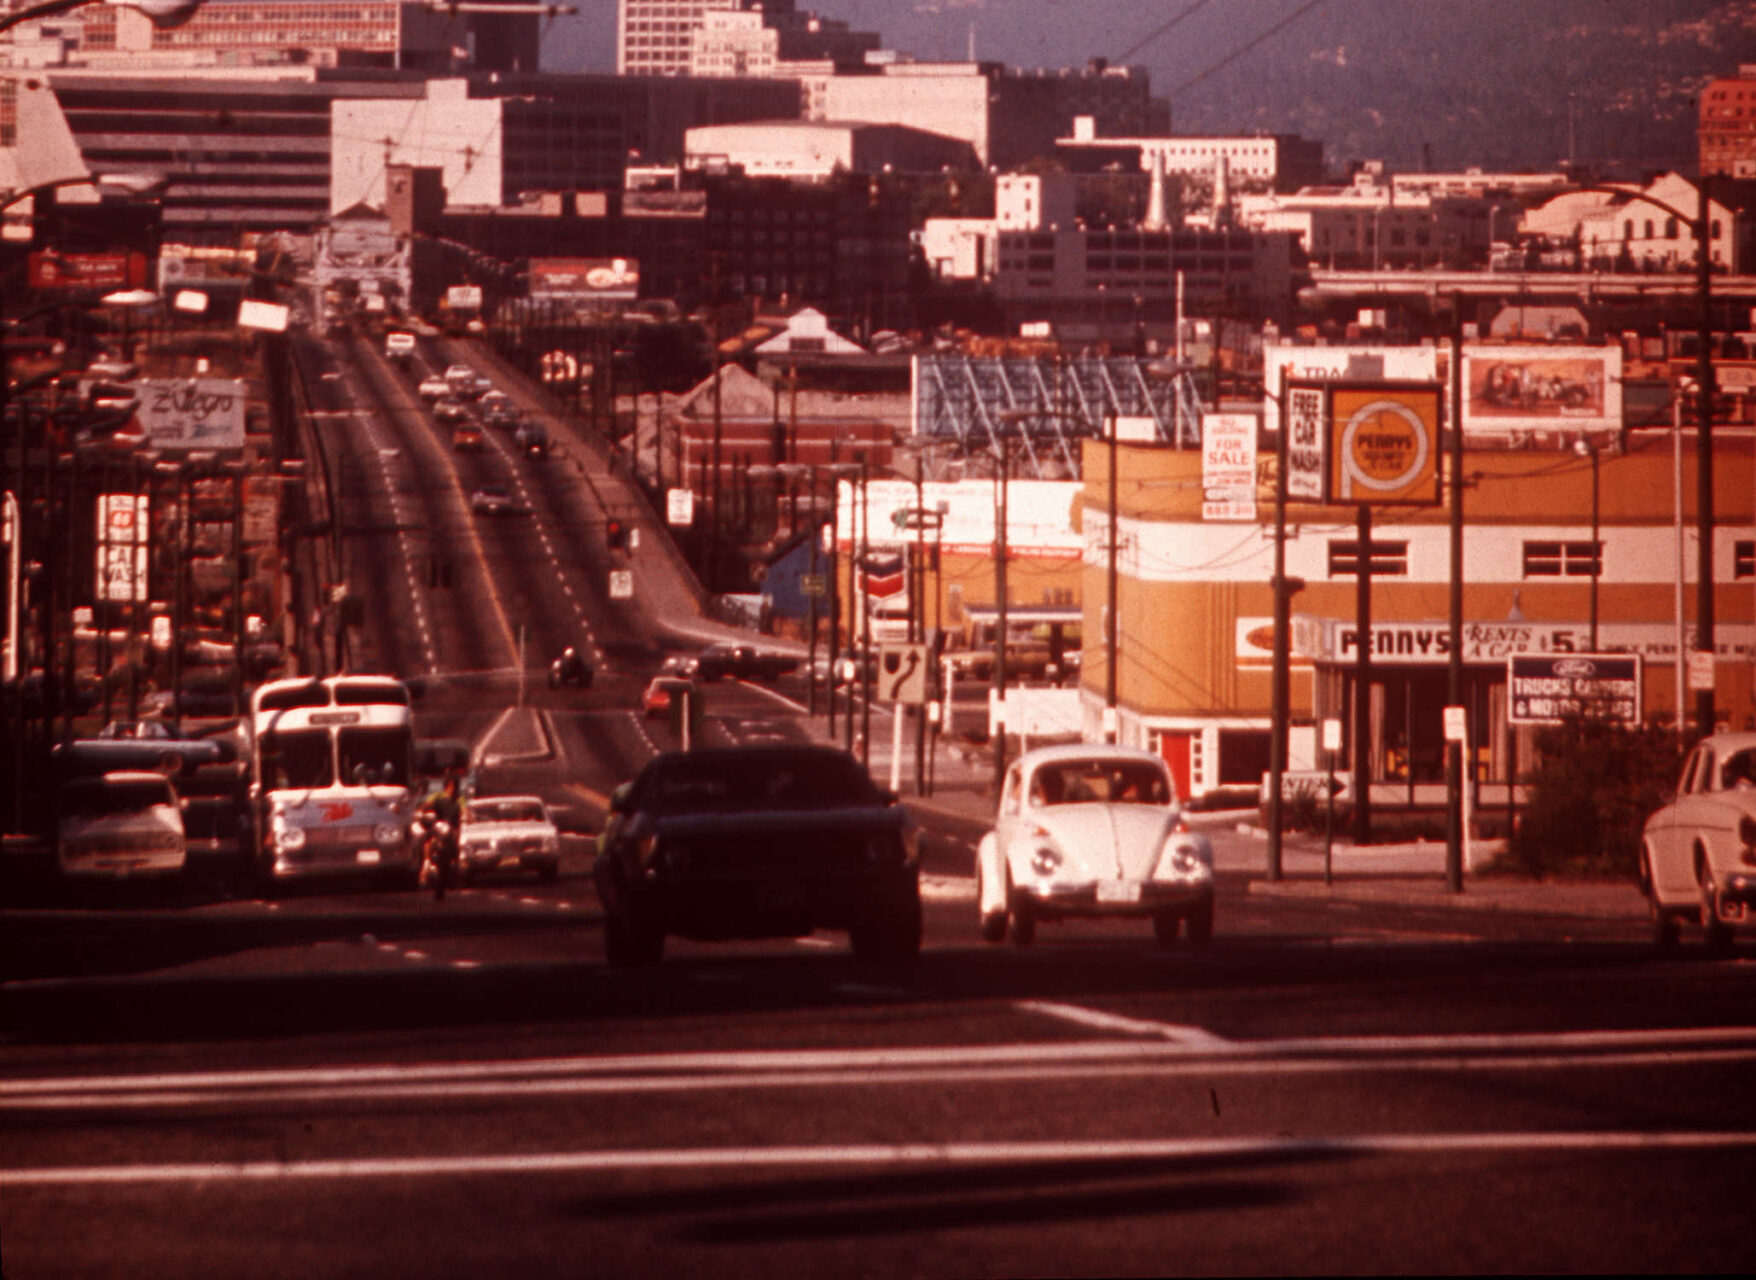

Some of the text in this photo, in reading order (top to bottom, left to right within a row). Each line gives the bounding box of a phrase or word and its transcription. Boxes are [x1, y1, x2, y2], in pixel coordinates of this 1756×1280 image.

[1216, 439, 1242, 450] FOR
[1208, 451, 1250, 466] SALE
[1514, 678, 1571, 696] TRUCKS
